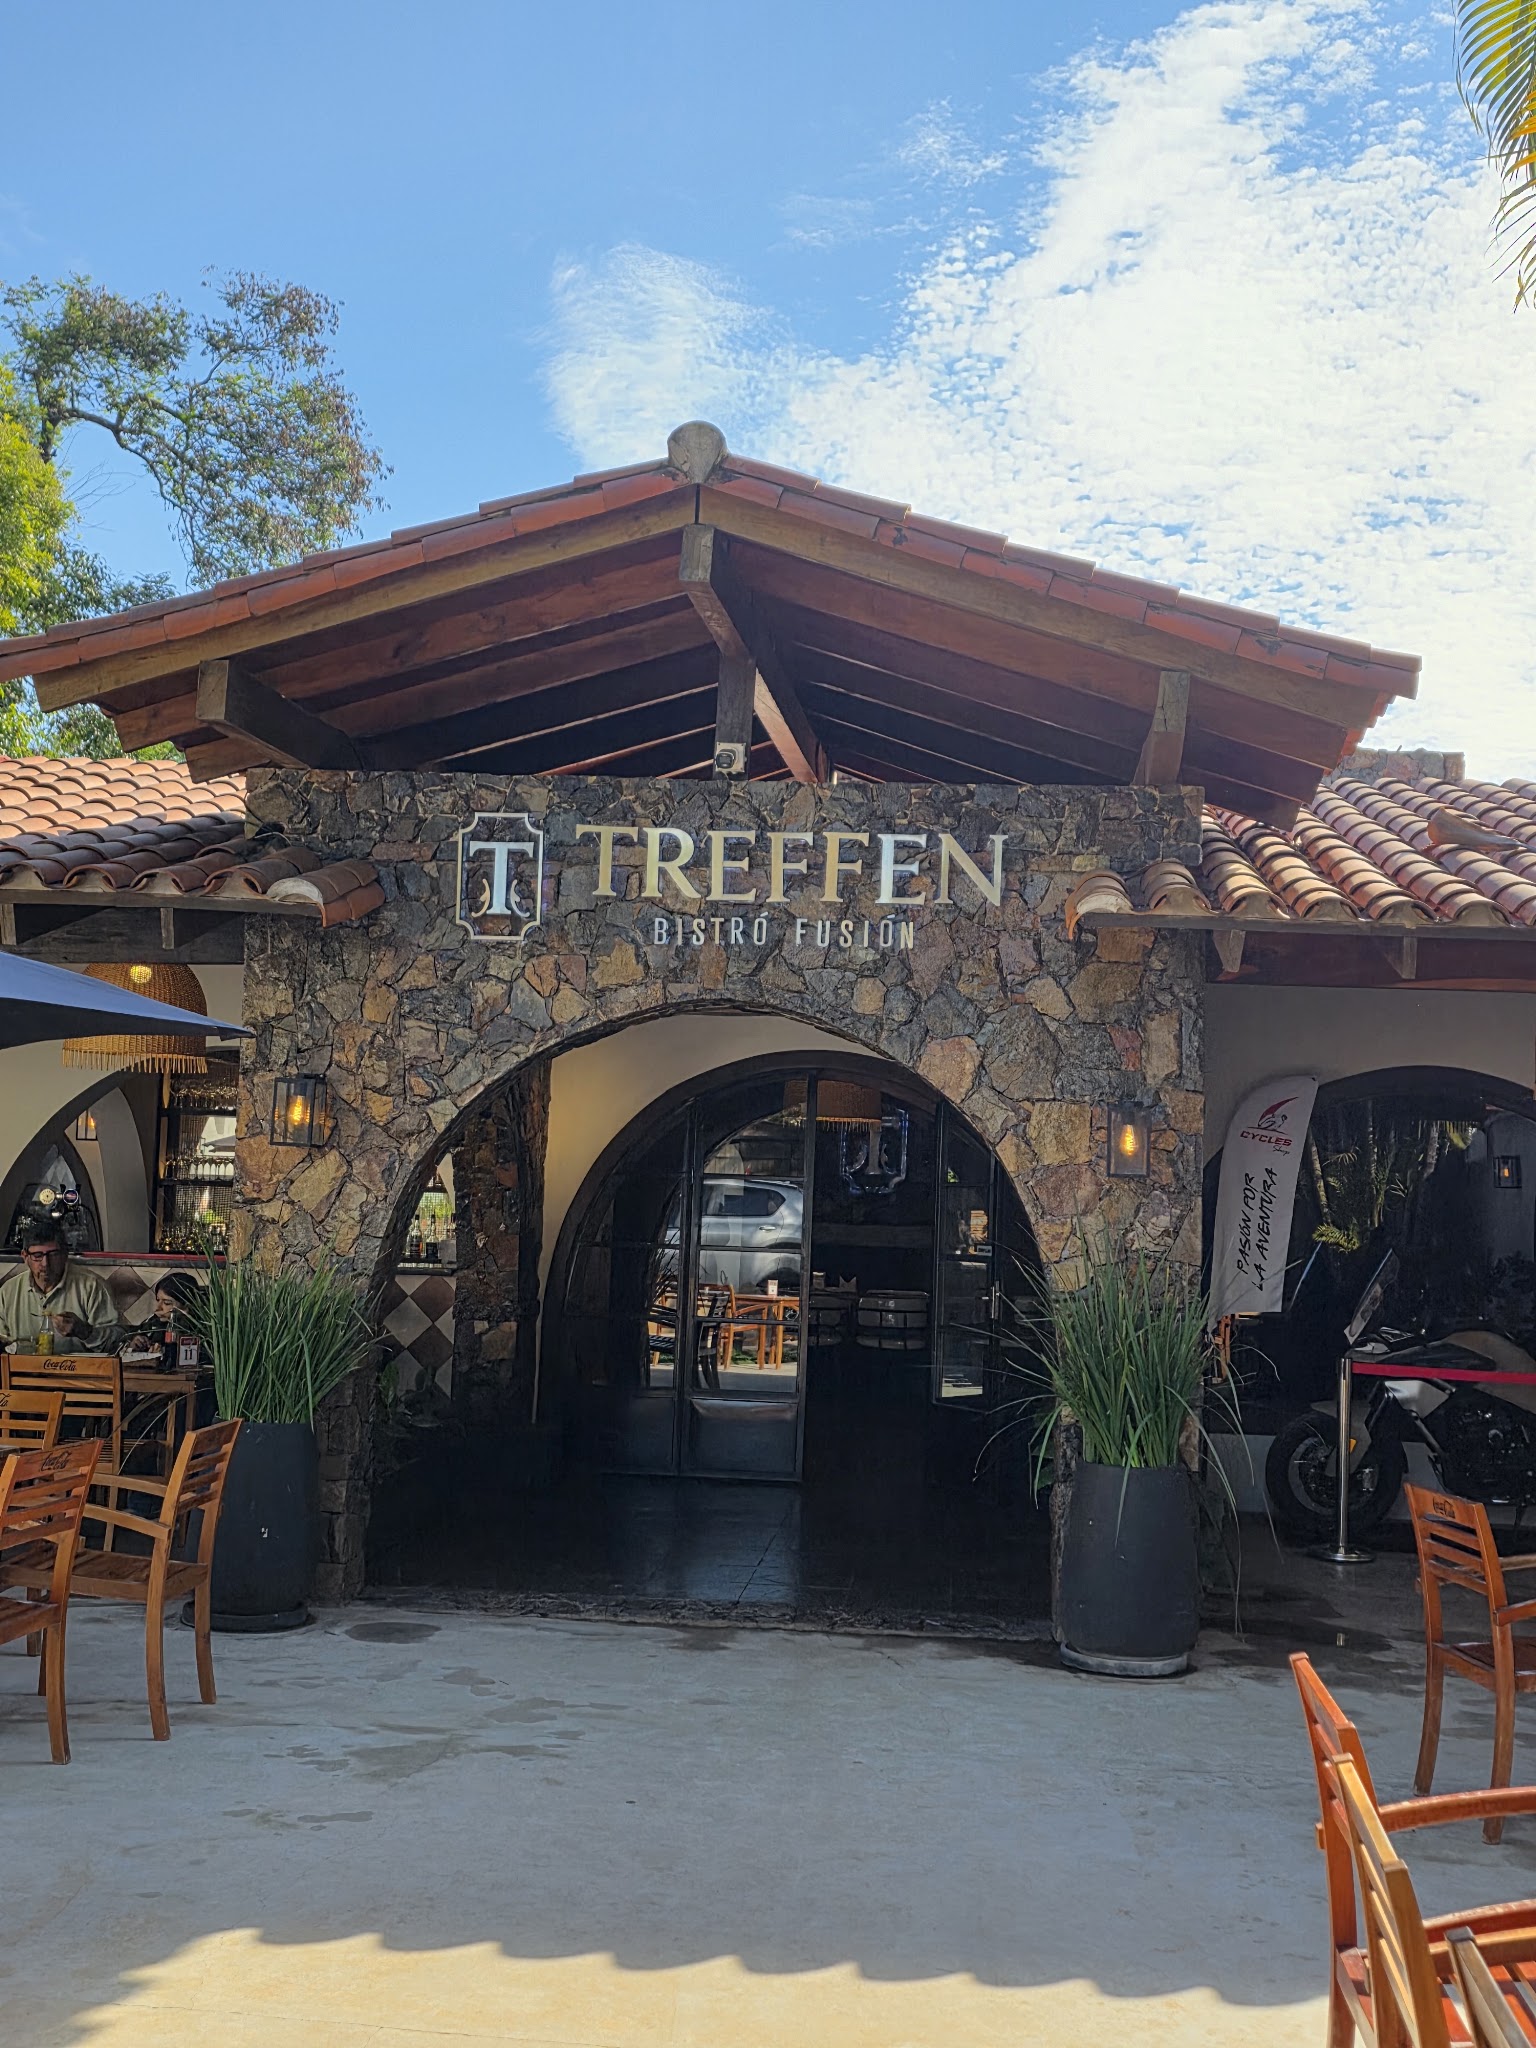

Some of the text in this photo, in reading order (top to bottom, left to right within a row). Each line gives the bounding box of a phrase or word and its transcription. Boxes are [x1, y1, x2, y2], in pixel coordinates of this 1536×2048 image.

[469, 840, 535, 916] T
[575, 823, 1009, 907] TREFFEN
[653, 911, 914, 950] BISTRÓ FUSIÓN
[1240, 1130, 1293, 1147] CYCLES
[1236, 1172, 1259, 1275] PASIÓN POR
[1251, 1167, 1278, 1292] LA AVENTURA
